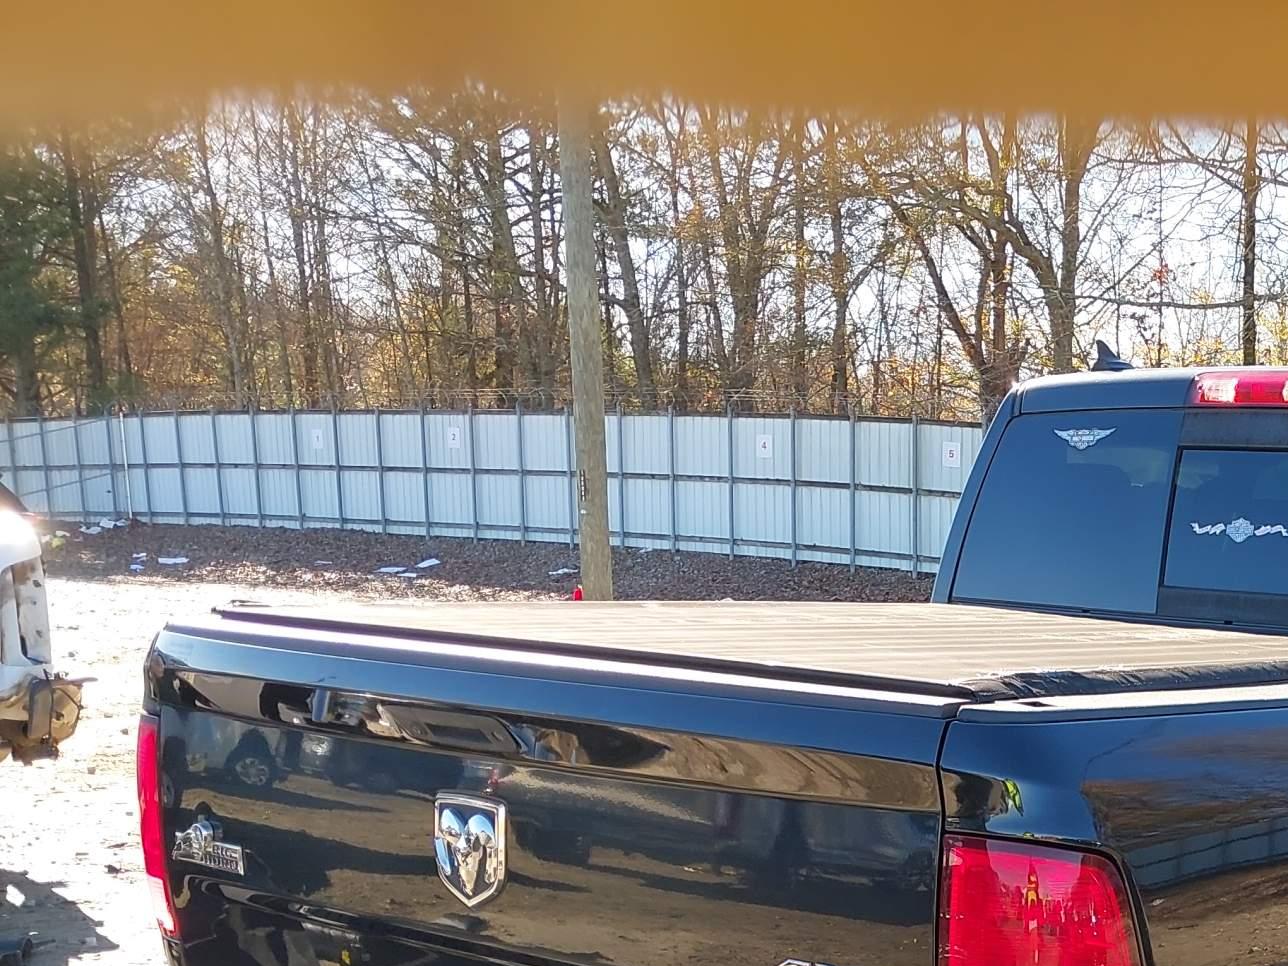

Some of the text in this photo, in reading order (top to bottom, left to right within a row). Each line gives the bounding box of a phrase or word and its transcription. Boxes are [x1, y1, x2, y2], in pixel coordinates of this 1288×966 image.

[451, 433, 456, 441] 2
[761, 441, 767, 450] 4
[948, 449, 955, 458] 5
[211, 844, 238, 860] BIG
